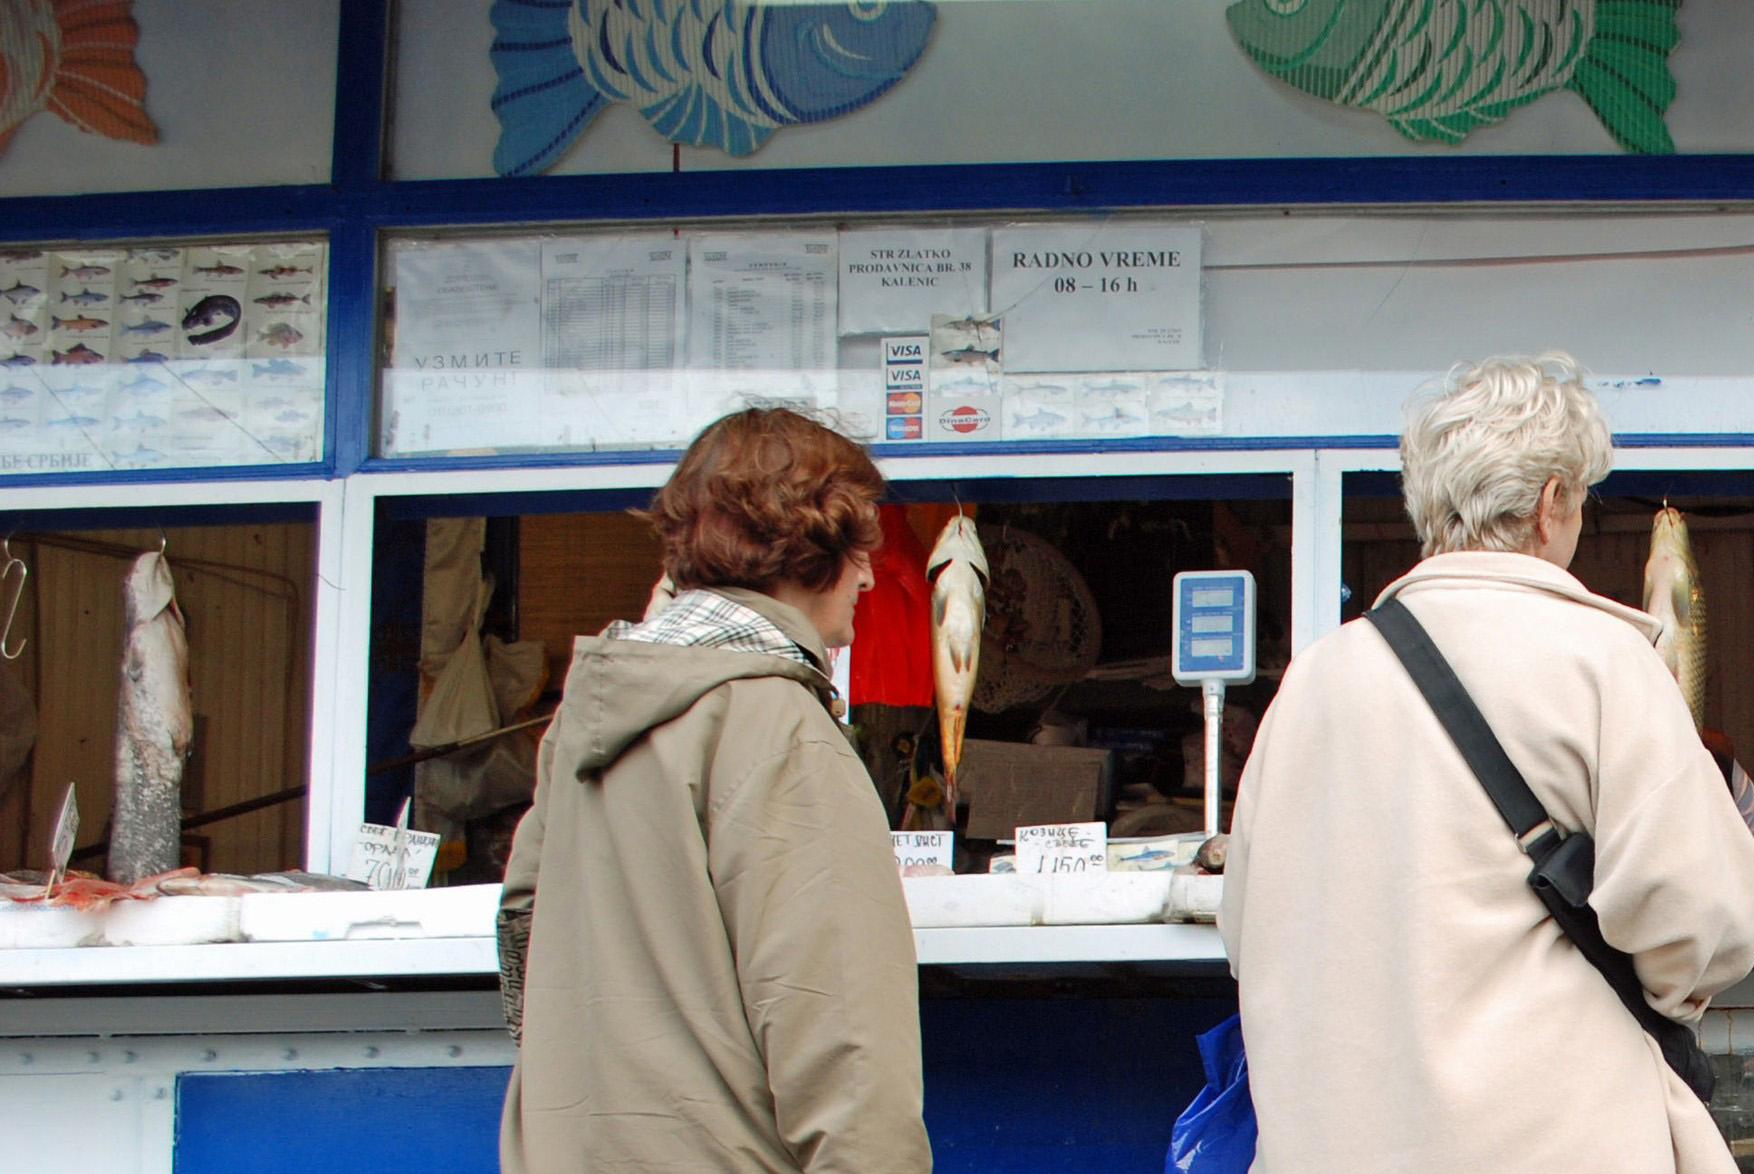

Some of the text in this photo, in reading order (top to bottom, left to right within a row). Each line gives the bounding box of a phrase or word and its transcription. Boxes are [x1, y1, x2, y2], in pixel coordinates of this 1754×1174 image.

[870, 248, 951, 260] STR ZLATKO
[1012, 251, 1182, 269] RADNO VREME
[849, 263, 934, 274] PRODAVNICA
[959, 261, 972, 272] 38
[881, 277, 940, 288] KALENIC
[1054, 277, 1076, 294] 08
[1100, 277, 1121, 293] 16
[1127, 277, 1138, 293] h
[891, 345, 922, 357] VISA
[415, 350, 523, 370] УЗМИТЕ
[421, 371, 517, 392] РАЧУН!
[891, 370, 922, 382] VISA
[27, 453, 92, 469] СРБИЈЕ
